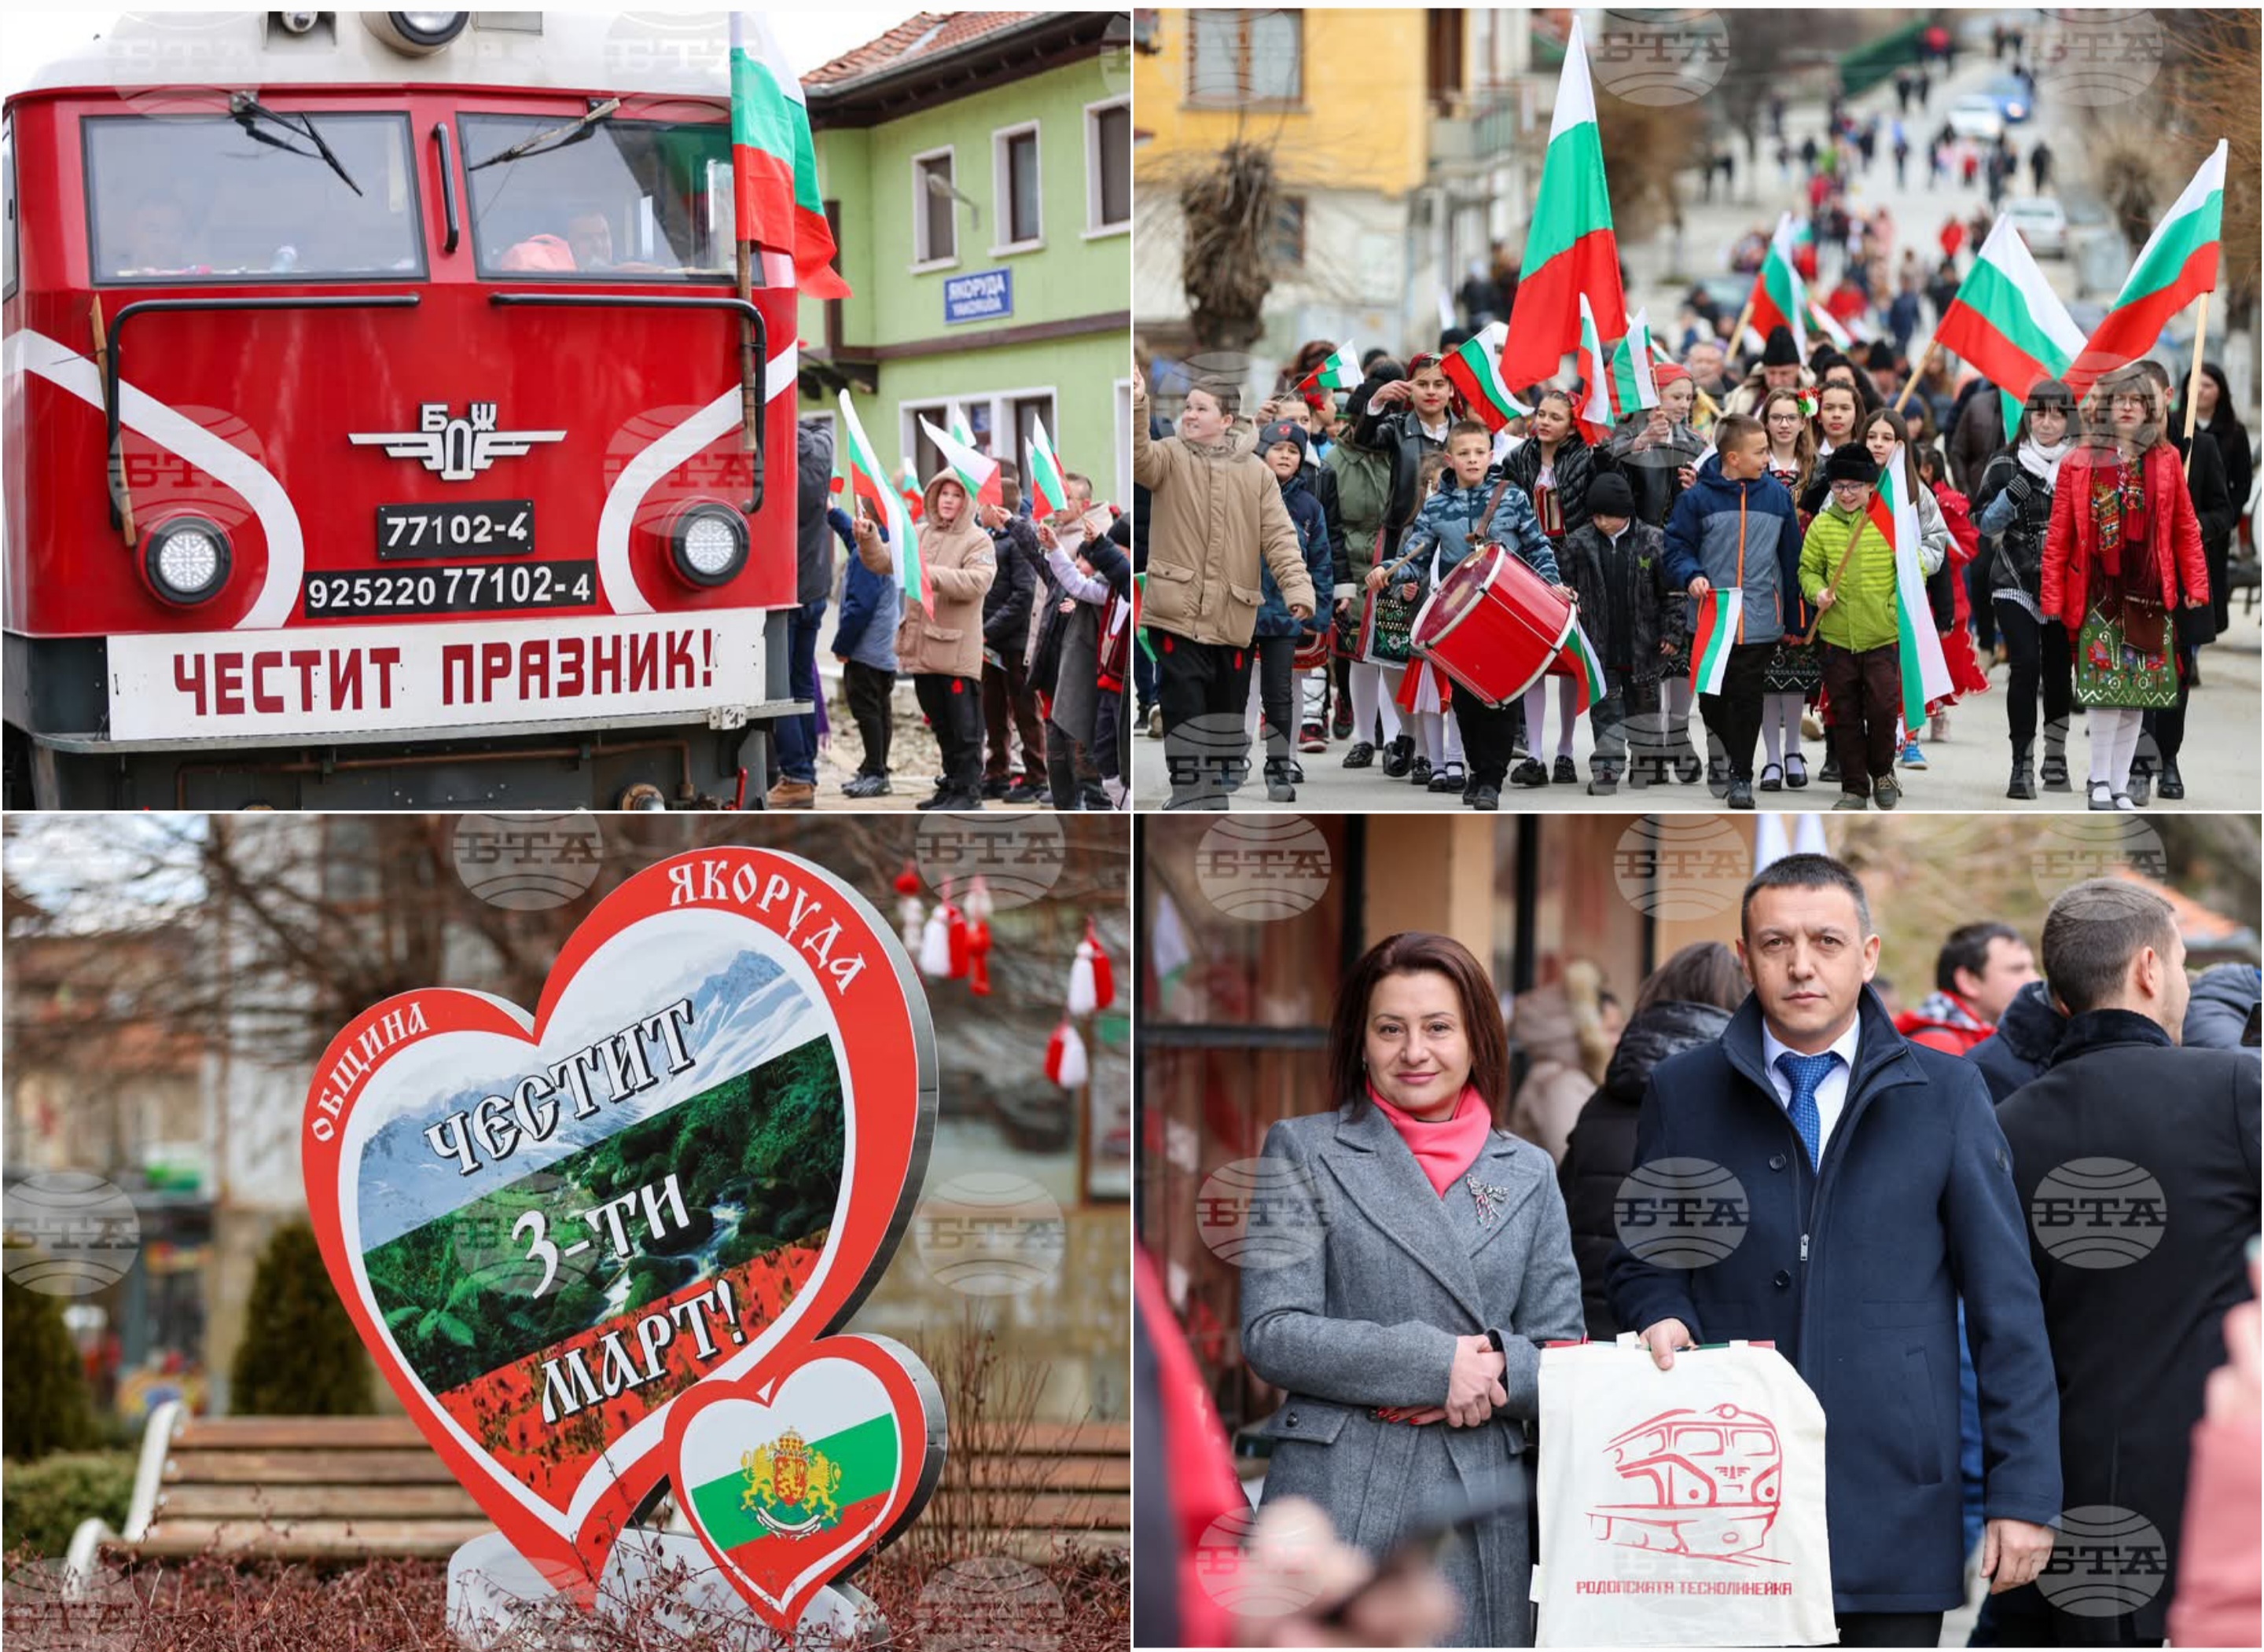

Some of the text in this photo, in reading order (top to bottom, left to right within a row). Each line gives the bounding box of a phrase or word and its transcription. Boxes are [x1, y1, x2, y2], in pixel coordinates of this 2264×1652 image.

[386, 512, 527, 547] 77102-4
[174, 629, 712, 716] ЧЕСТИТ ПРАЗНИК!
[311, 860, 866, 1142] ОБЩИНА ЯКОРУДА
[422, 998, 696, 1176] ЧЕСТИТ
[542, 1278, 744, 1424] МАРТ!
[1575, 1580, 1792, 1595] РОДОПСКАТА ТЕСНОЛИНЕЙКА
